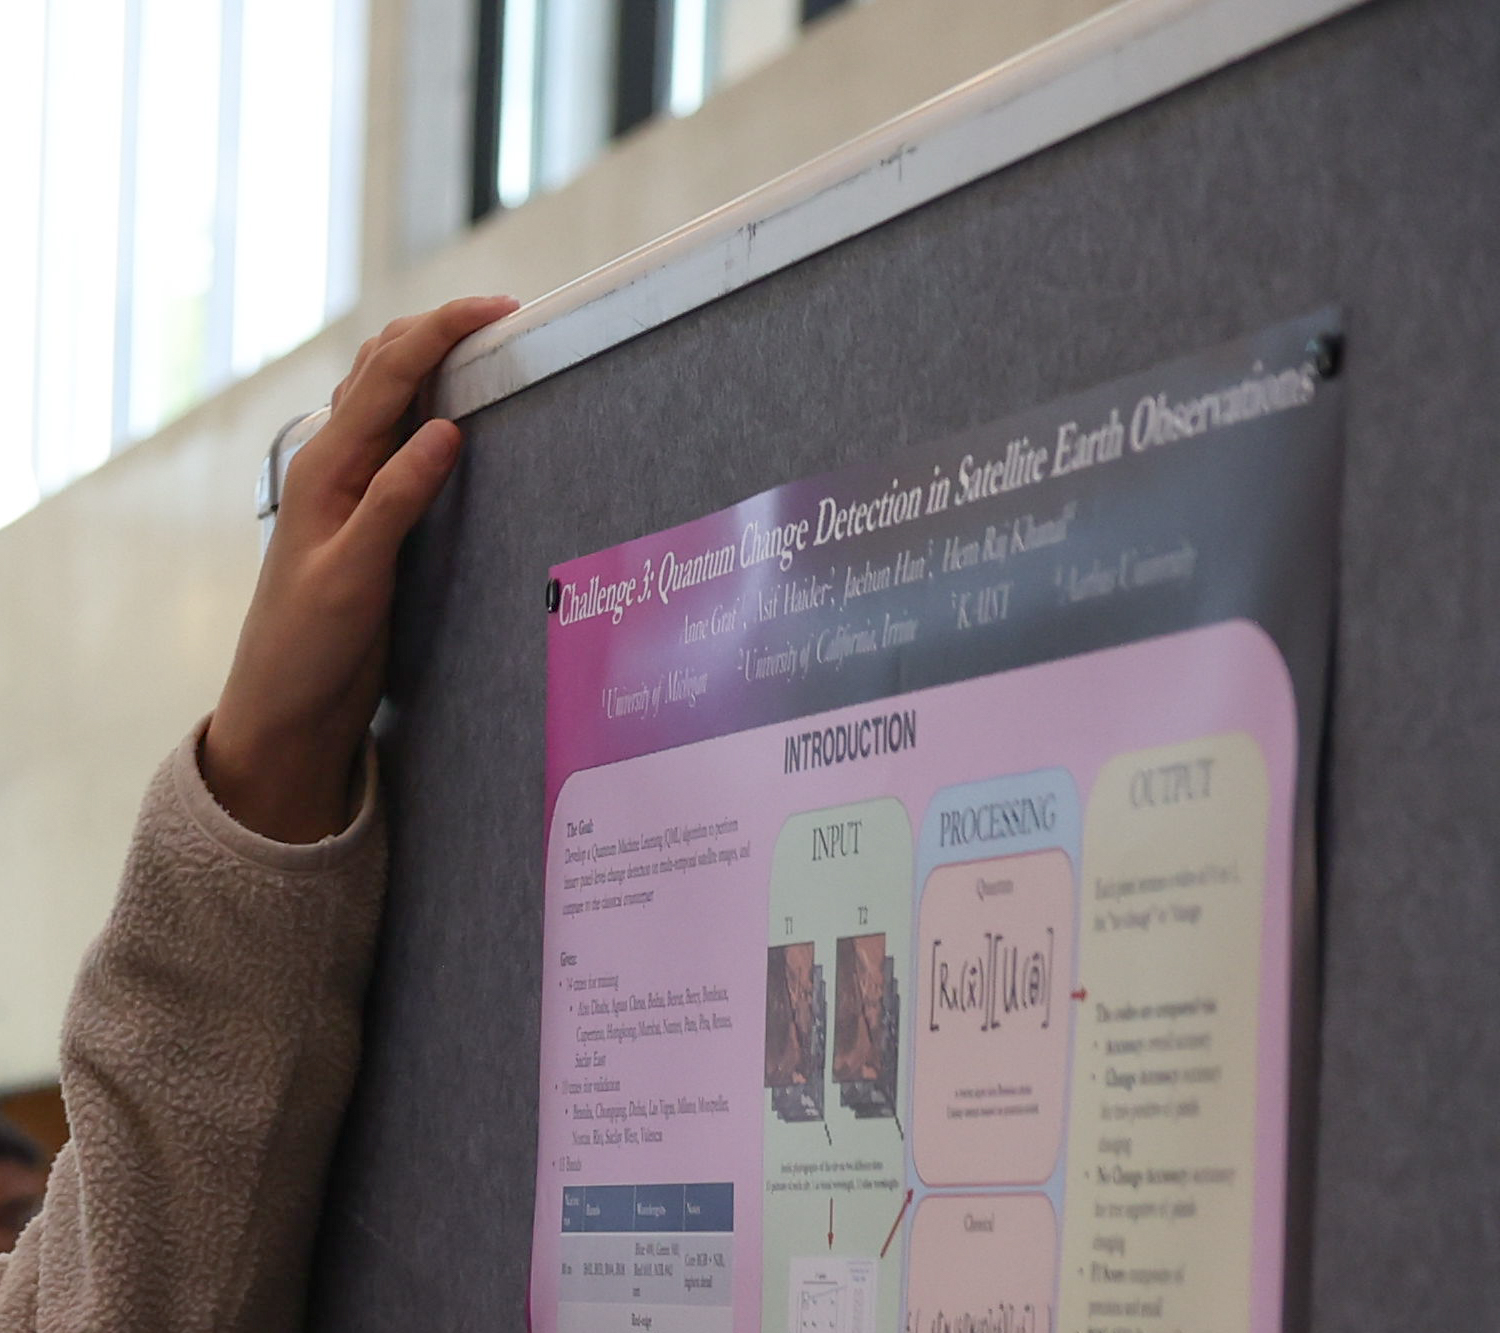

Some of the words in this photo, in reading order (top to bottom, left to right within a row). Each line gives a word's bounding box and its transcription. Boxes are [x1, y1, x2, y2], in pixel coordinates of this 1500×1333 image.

[558, 574, 636, 625] Challenge
[637, 559, 654, 602] 3:
[658, 543, 736, 604] Quantum
[740, 519, 808, 571] Change
[813, 479, 922, 546] Detection
[926, 466, 951, 514] in
[955, 437, 1047, 506] Satellite
[1050, 408, 1124, 477] Earth
[784, 709, 916, 775] INTRODUCTION
[1128, 757, 1216, 810] OUTPUT
[812, 819, 862, 862] INPUT
[940, 793, 1057, 848] PROCESSING
